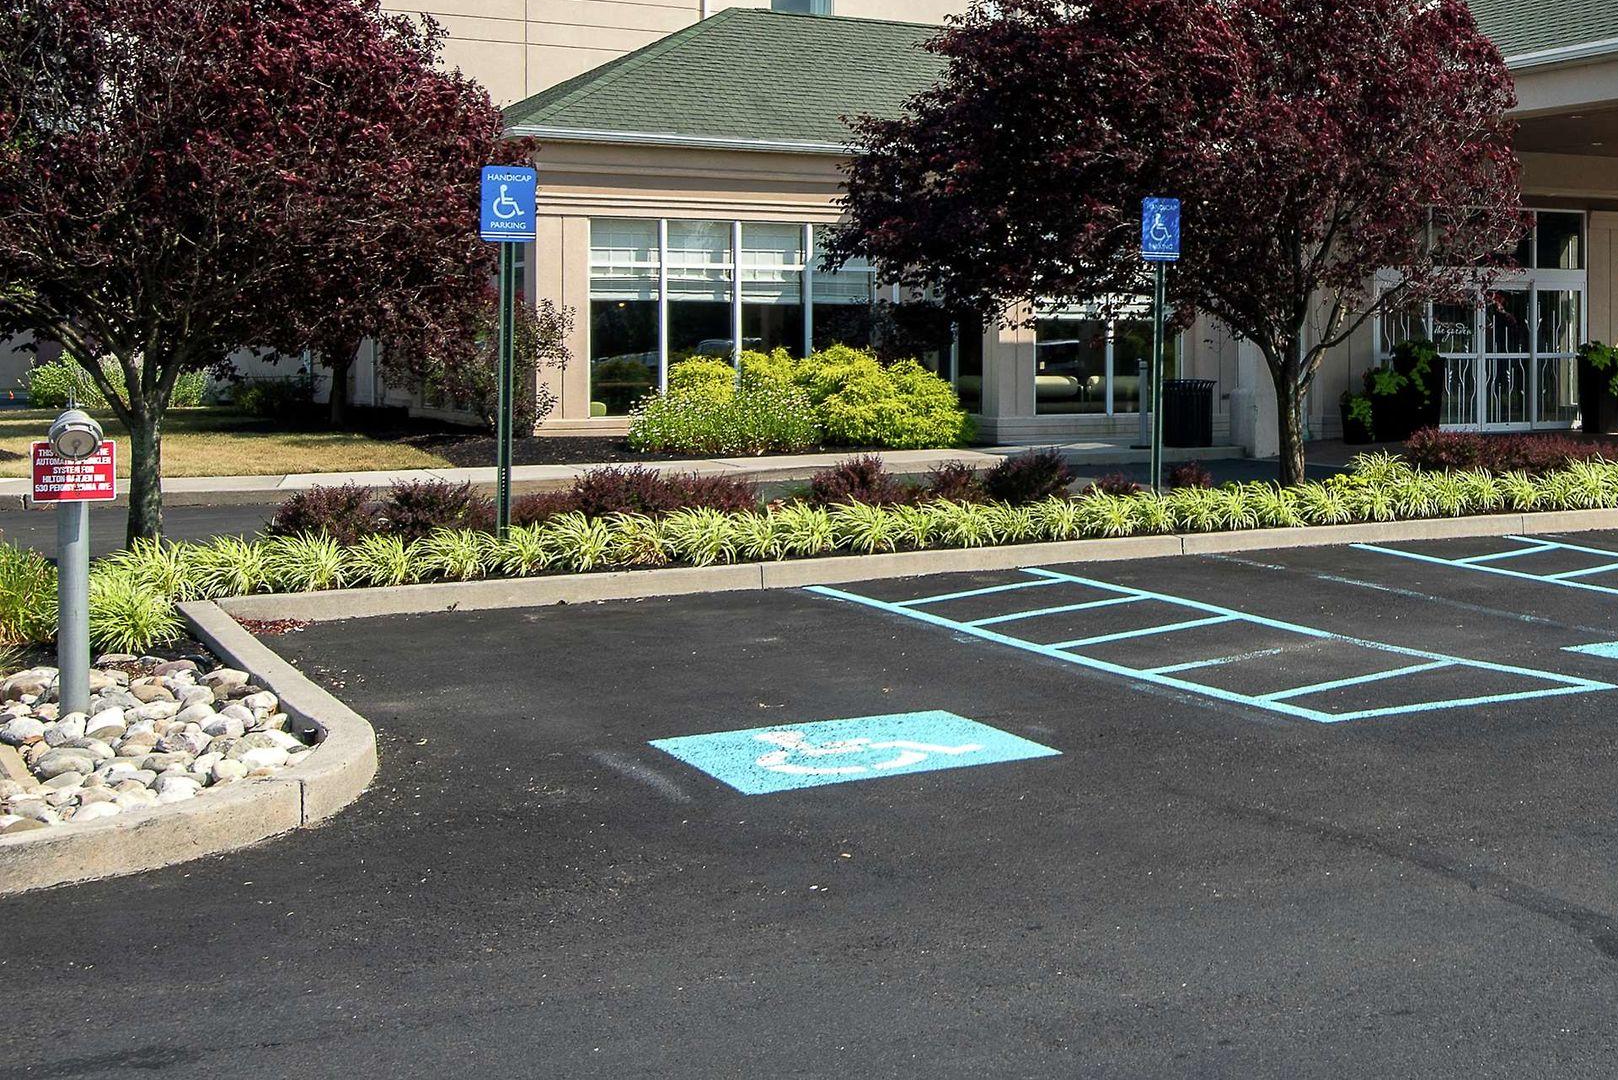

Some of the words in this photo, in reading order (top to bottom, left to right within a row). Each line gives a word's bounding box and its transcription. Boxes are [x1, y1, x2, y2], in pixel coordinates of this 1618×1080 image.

[487, 173, 532, 182] HANDICAP
[490, 221, 527, 230] PARKING
[38, 449, 54, 457] THIS
[53, 466, 80, 474] SYSTEM
[42, 475, 66, 483] HILTON
